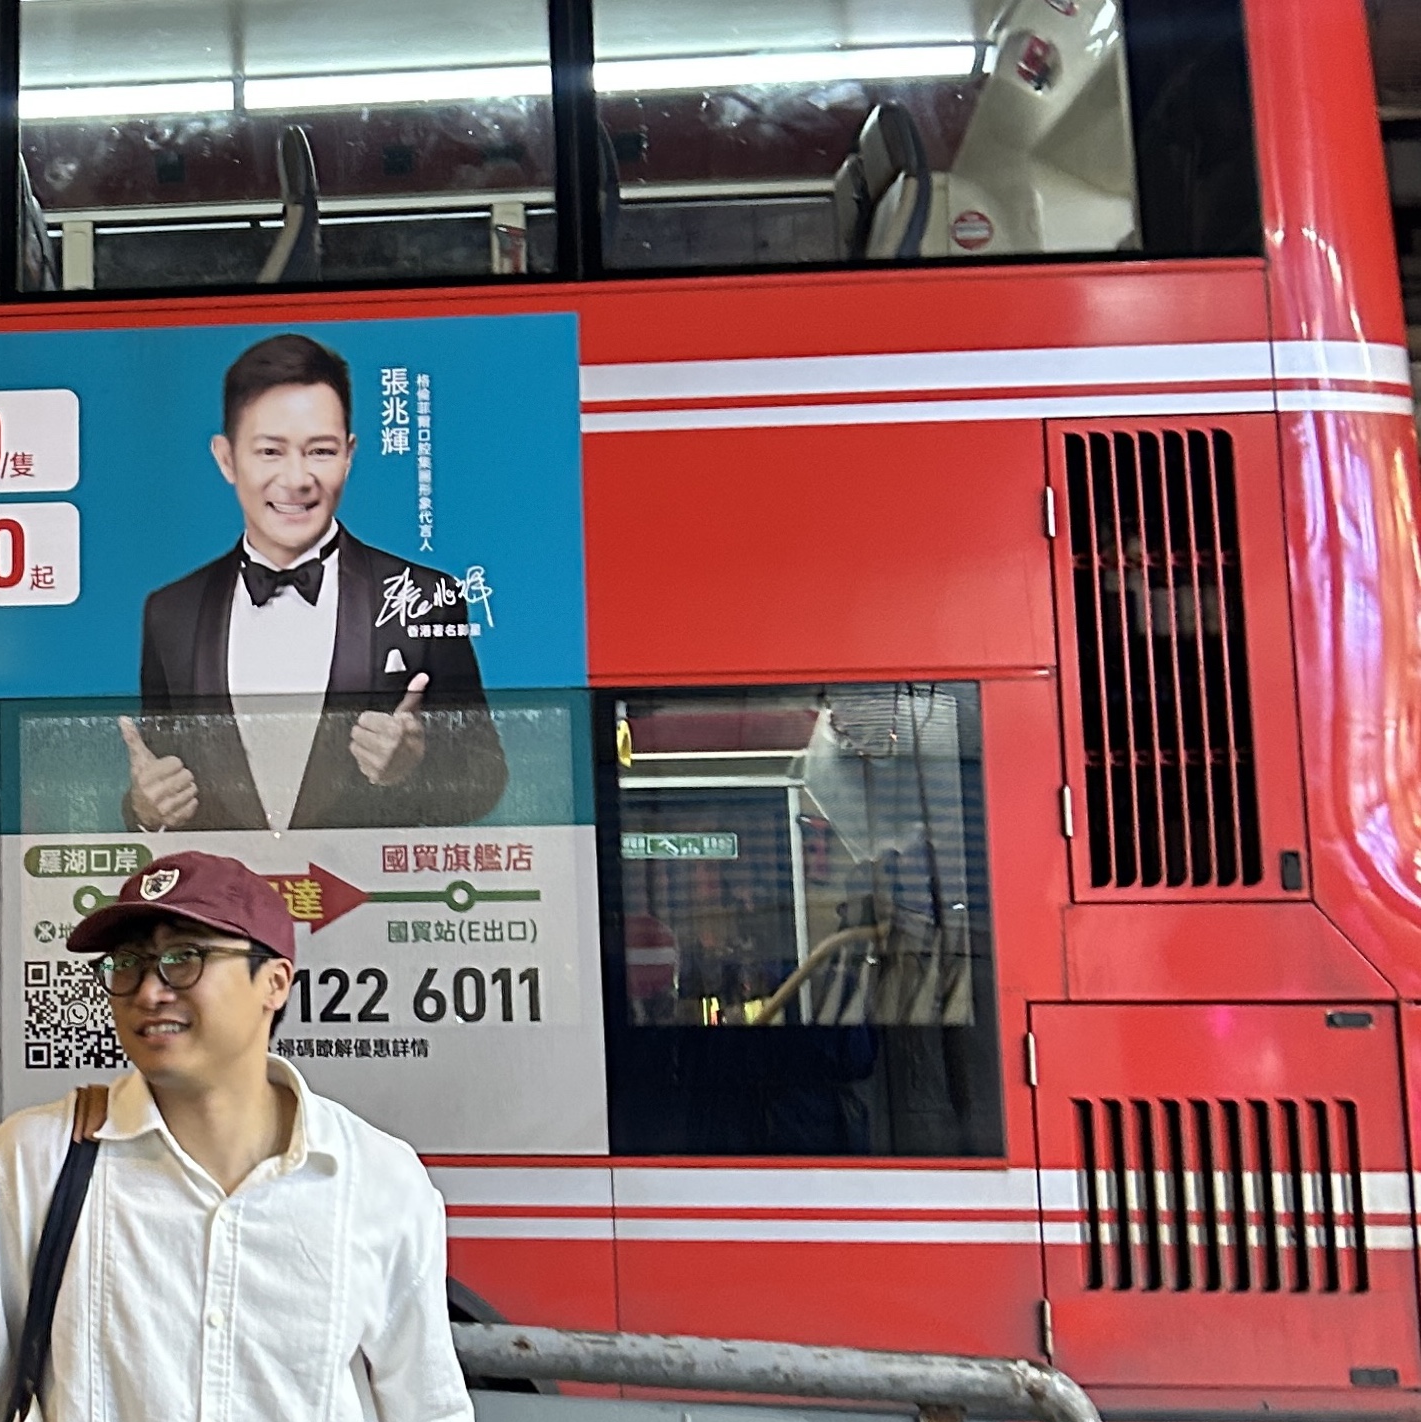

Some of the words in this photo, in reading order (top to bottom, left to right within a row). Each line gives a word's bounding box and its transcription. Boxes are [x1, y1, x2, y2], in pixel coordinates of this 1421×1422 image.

[380, 368, 411, 455] 張兆輝
[38, 848, 138, 874] 羅湖口岸
[382, 843, 533, 873] 國貿旗艦店
[387, 918, 538, 945] 國貿站(E出口)
[412, 967, 541, 1023] 6011
[277, 1037, 429, 1059] 掃碼瞭解優惠詳情
